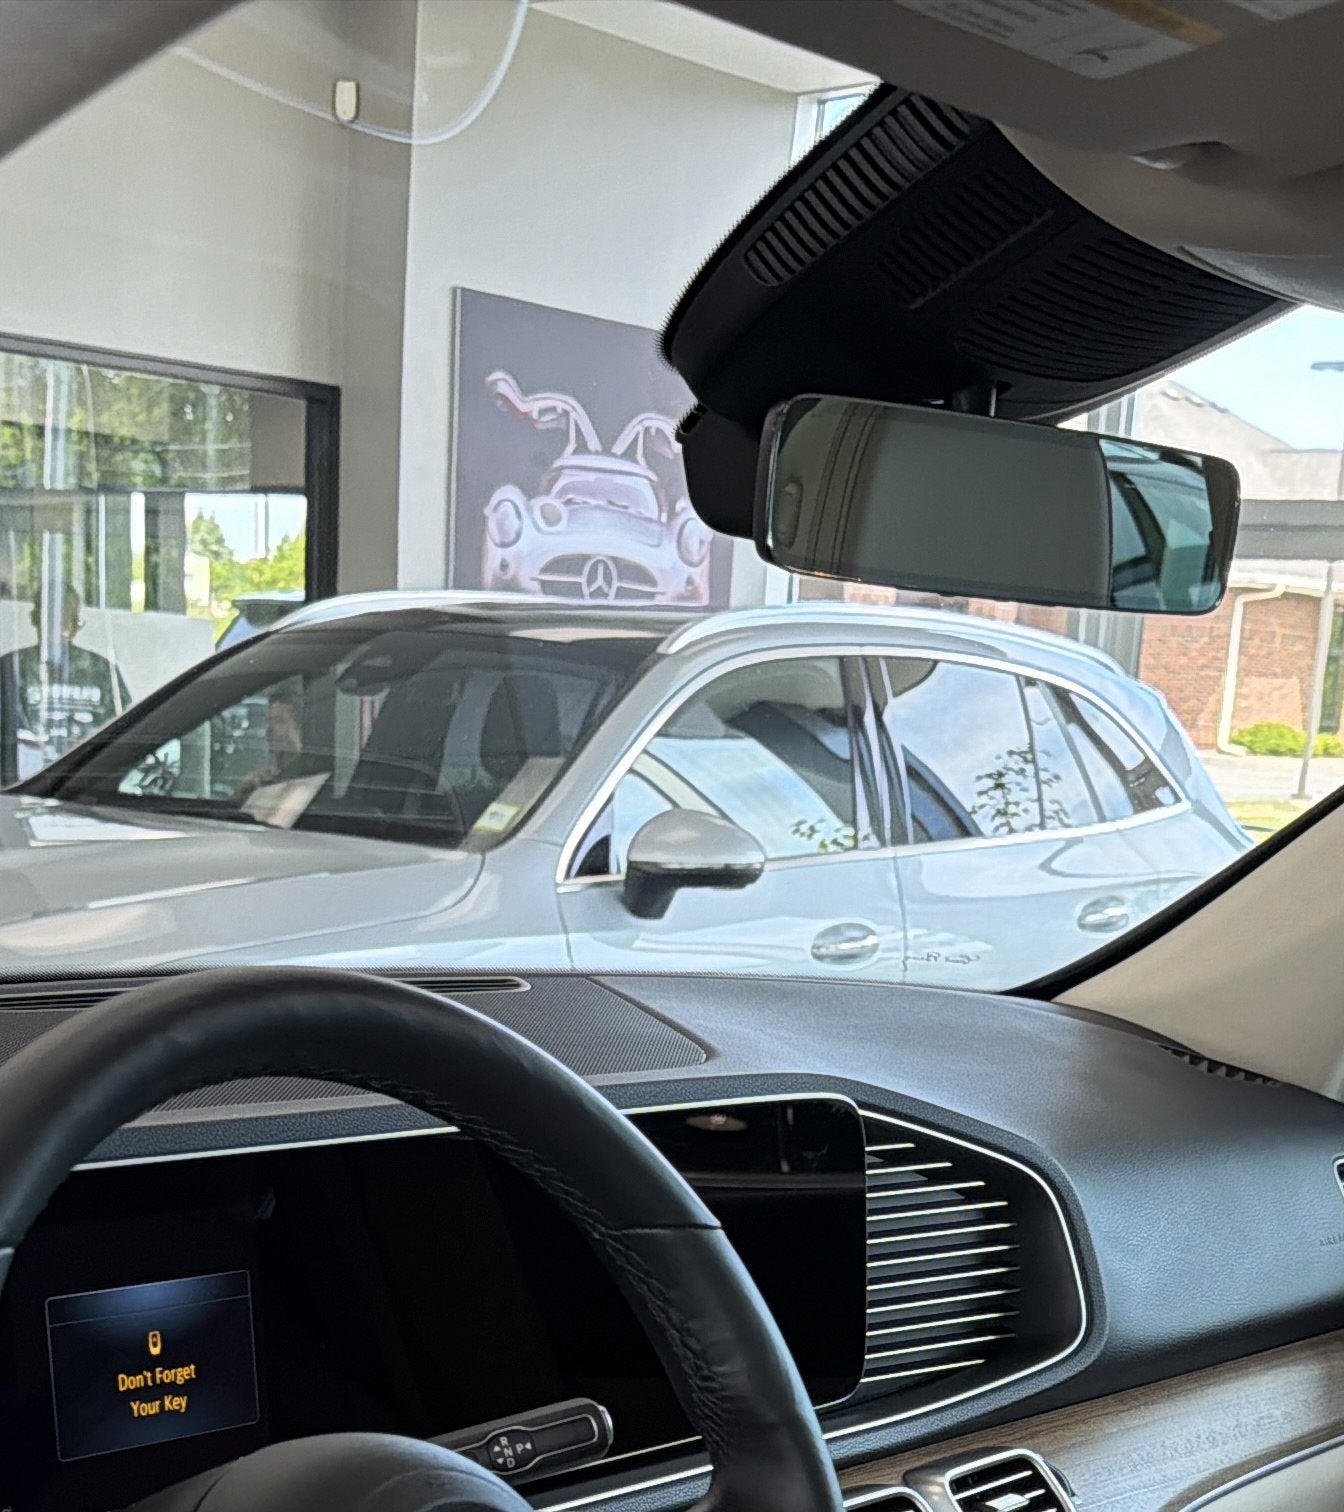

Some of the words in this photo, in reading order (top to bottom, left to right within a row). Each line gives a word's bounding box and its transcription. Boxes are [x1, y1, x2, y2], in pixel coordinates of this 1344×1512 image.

[118, 1370, 153, 1392] Don't
[156, 1363, 197, 1388] Forget
[130, 1398, 162, 1417] Your
[164, 1394, 189, 1414] Key
[499, 1436, 510, 1447] R
[503, 1446, 514, 1458] N
[516, 1443, 524, 1455] P
[506, 1458, 516, 1468] D
